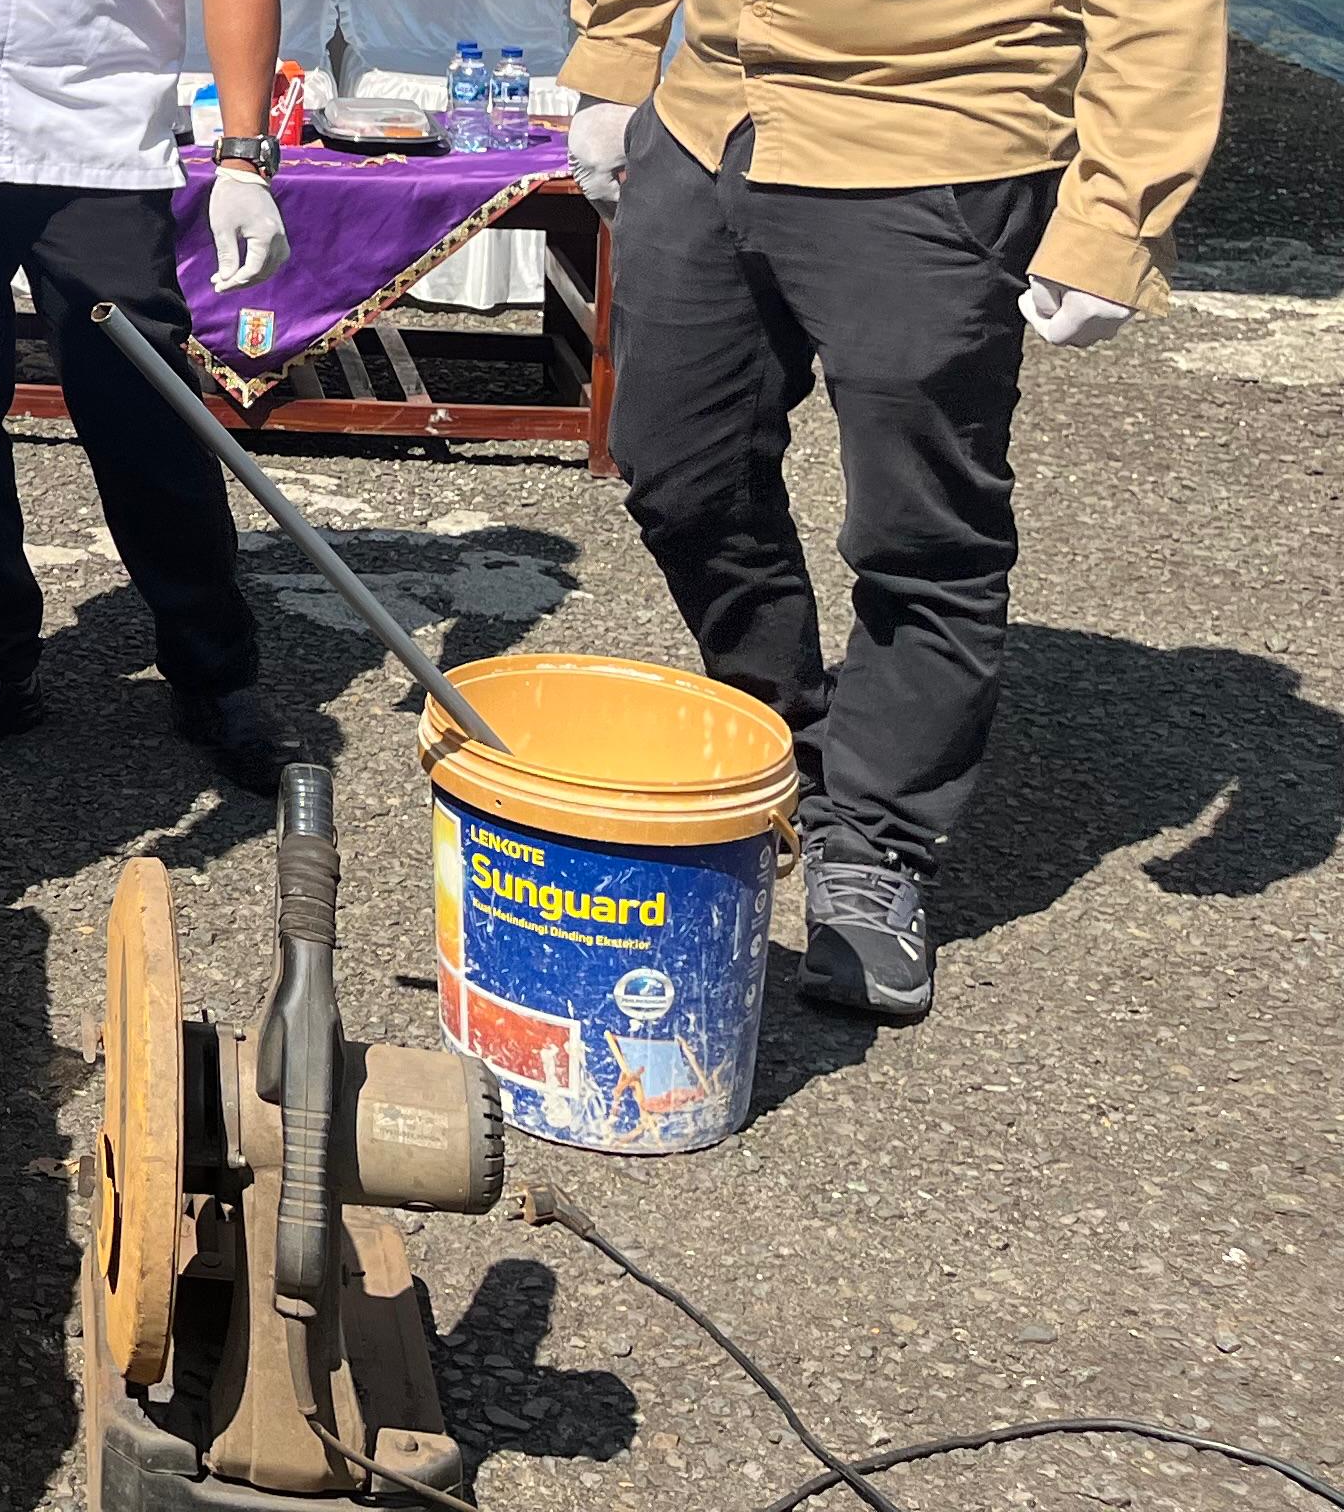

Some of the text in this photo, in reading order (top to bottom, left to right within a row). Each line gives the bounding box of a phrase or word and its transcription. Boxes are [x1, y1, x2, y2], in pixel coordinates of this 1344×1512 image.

[470, 824, 545, 867] LENKOTE
[471, 852, 666, 927] Sunguard
[550, 926, 593, 948] Dinding
